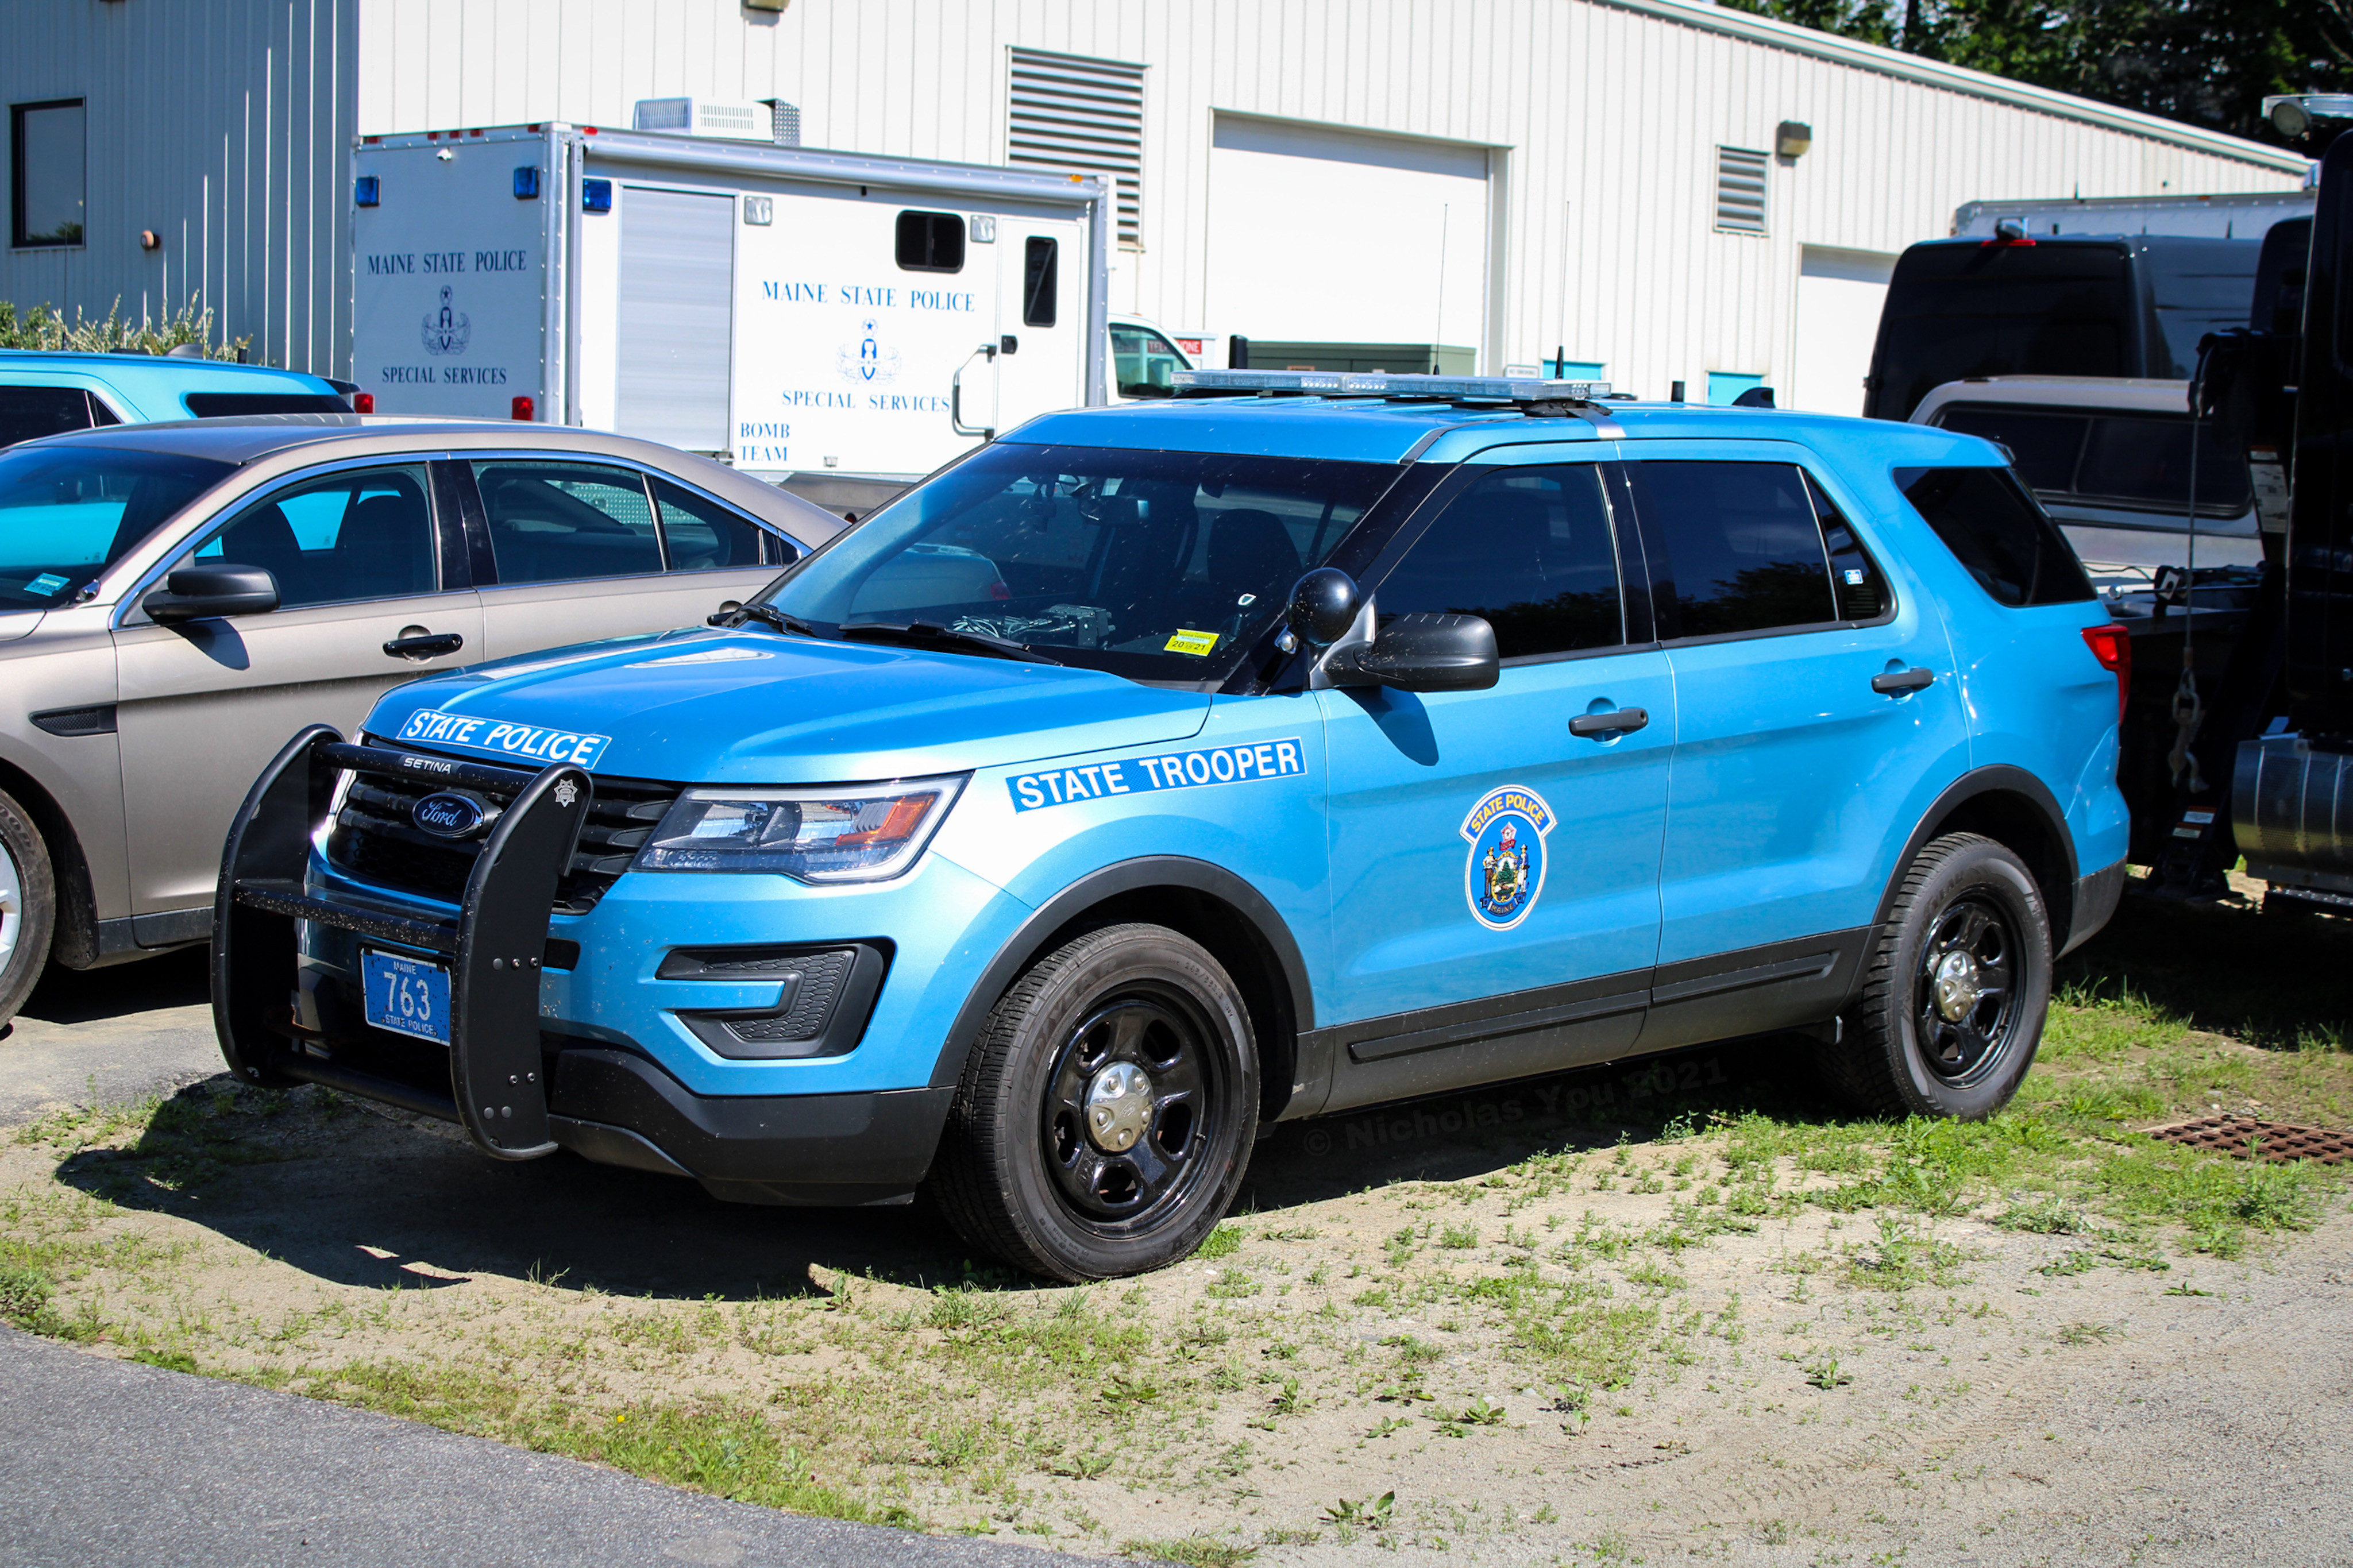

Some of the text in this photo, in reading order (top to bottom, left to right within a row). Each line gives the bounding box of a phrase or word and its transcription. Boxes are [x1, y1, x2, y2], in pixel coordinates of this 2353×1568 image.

[368, 250, 527, 275] MAINE STATE POLICE
[762, 281, 975, 312] MAINE STATE POLICE
[382, 366, 507, 385] SPECIAL SERVICES
[782, 390, 950, 412] SPECIAL SERVICES
[740, 422, 790, 439] BOMB
[739, 446, 788, 462] TEAM
[406, 711, 601, 765] STATE POLICE
[403, 757, 451, 774] SETINA
[1016, 742, 1299, 809] STATE TROOPER
[422, 800, 460, 827] Ford
[1471, 794, 1545, 833] STATE POLICE
[1491, 902, 1514, 913] MAINE
[394, 961, 416, 975] MAINE
[384, 971, 431, 1021] 763
[385, 1014, 434, 1034] STATE POLICE
